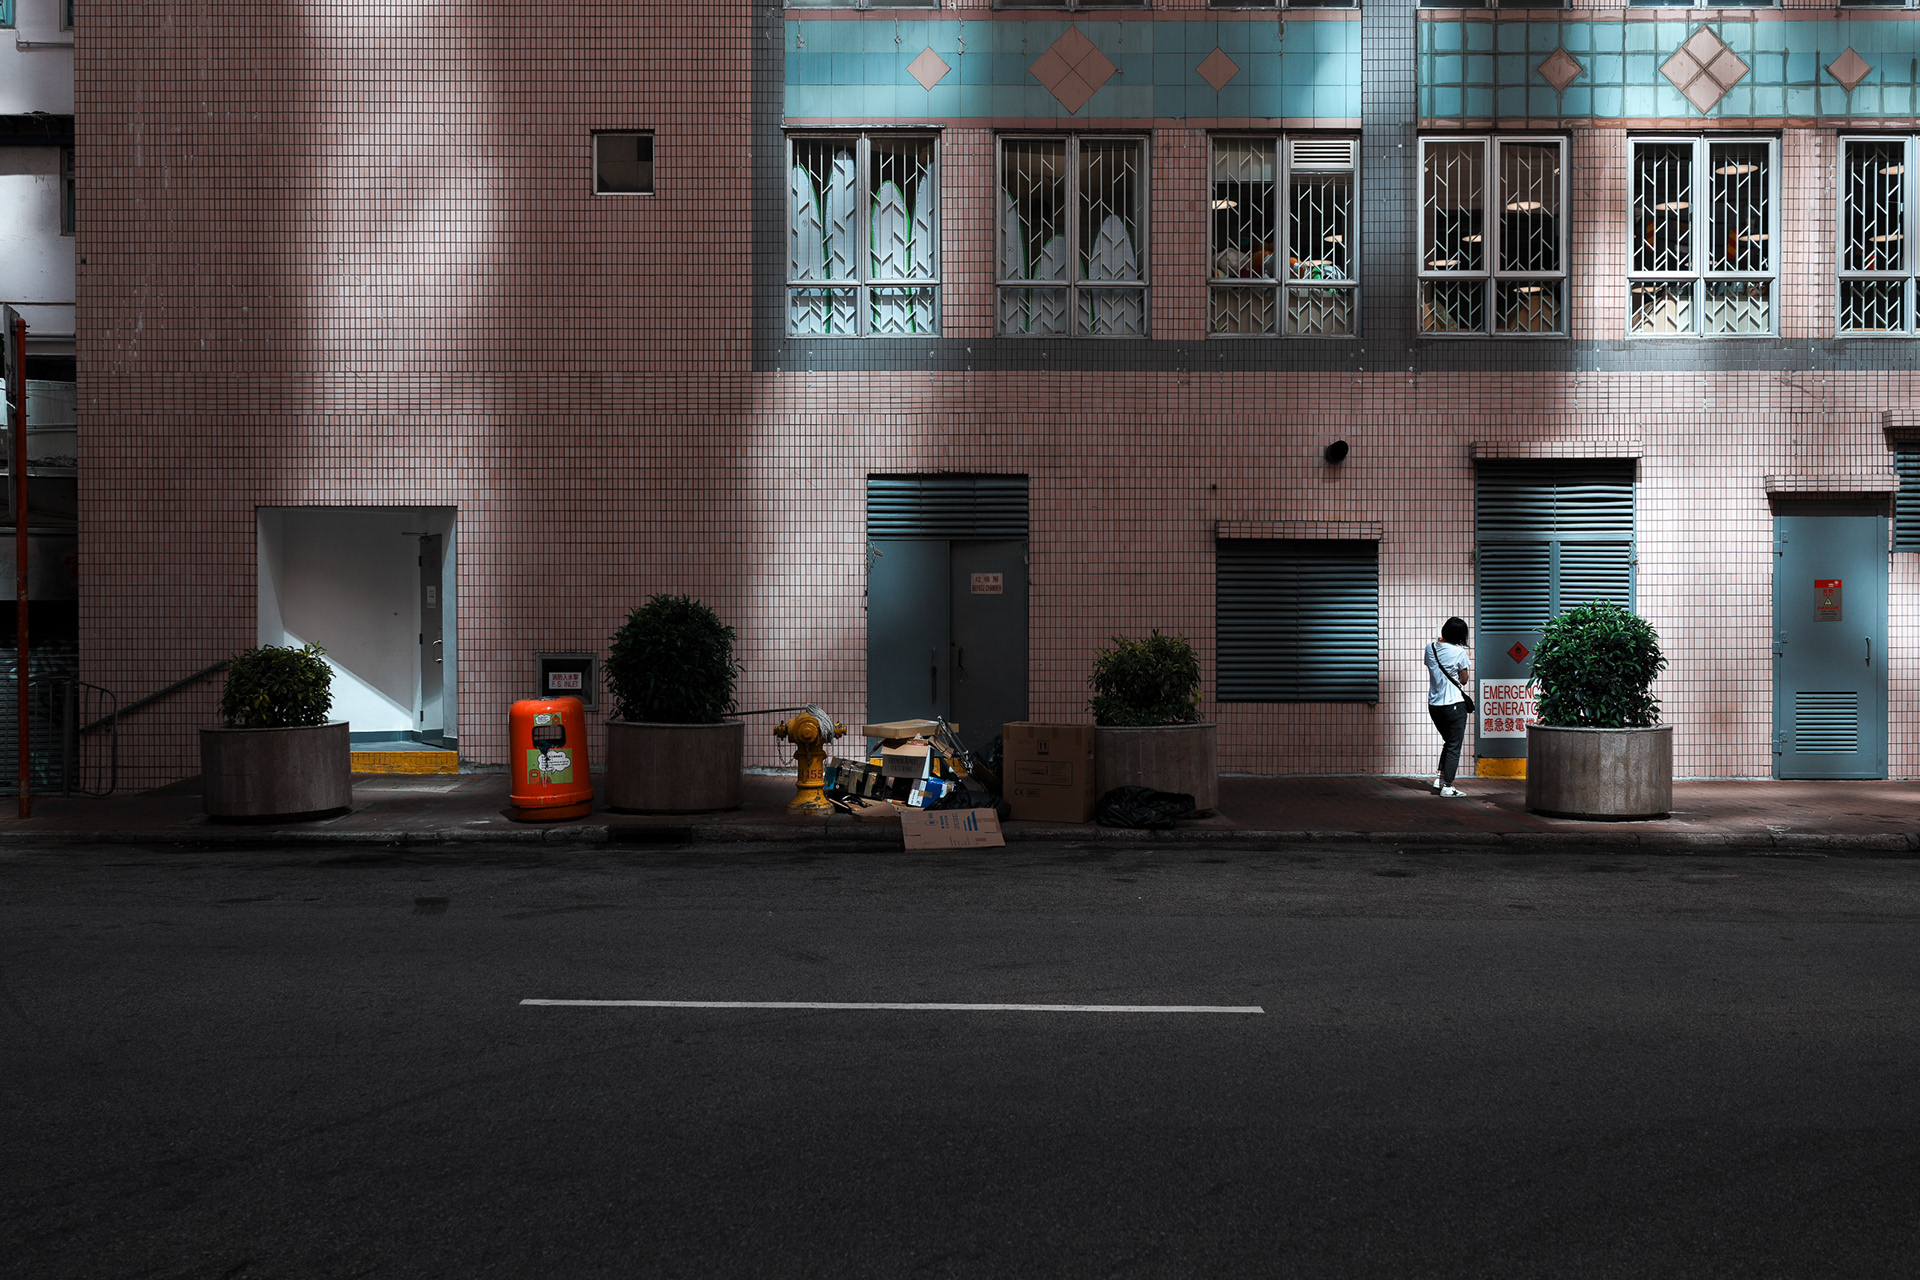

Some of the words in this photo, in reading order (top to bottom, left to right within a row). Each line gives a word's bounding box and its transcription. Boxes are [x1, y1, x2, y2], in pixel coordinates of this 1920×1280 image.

[1483, 685, 1543, 700] EMERGENC
[1483, 701, 1540, 716] GENERATO
[1483, 717, 1544, 732] 應急發電
